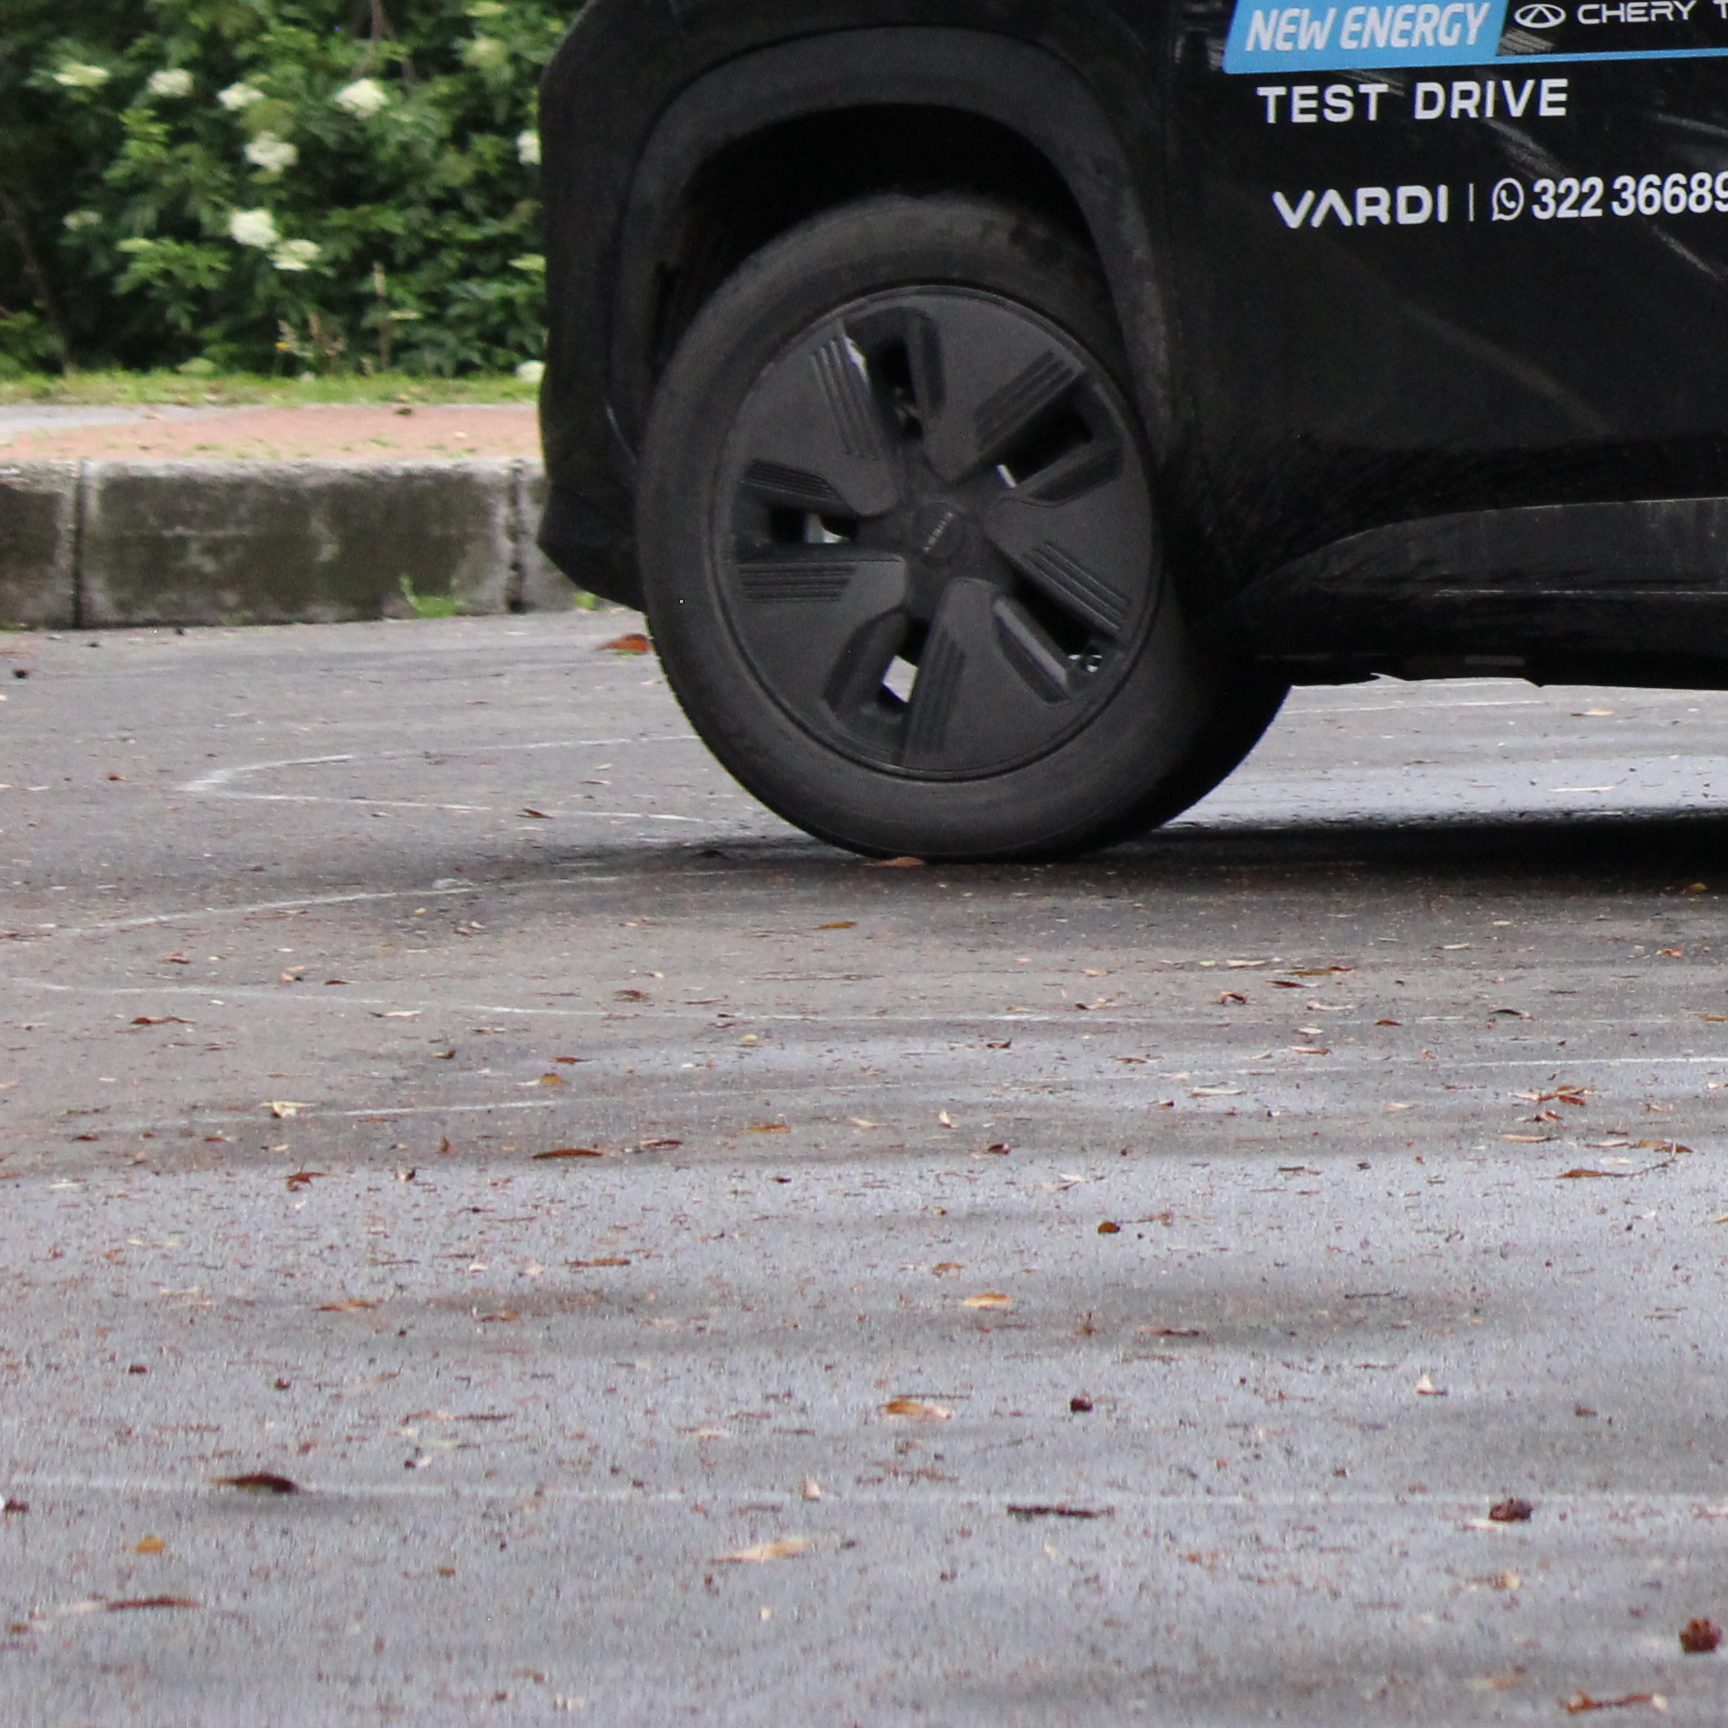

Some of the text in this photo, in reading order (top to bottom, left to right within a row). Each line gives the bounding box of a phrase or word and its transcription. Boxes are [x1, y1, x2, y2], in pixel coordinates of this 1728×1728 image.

[1245, 2, 1490, 52] NEW ENERGY
[1577, 0, 1698, 25] CHERY
[1257, 79, 1567, 123] TEST DRIVE
[1273, 184, 1448, 228] VARDI
[1531, 177, 1602, 220] 322
